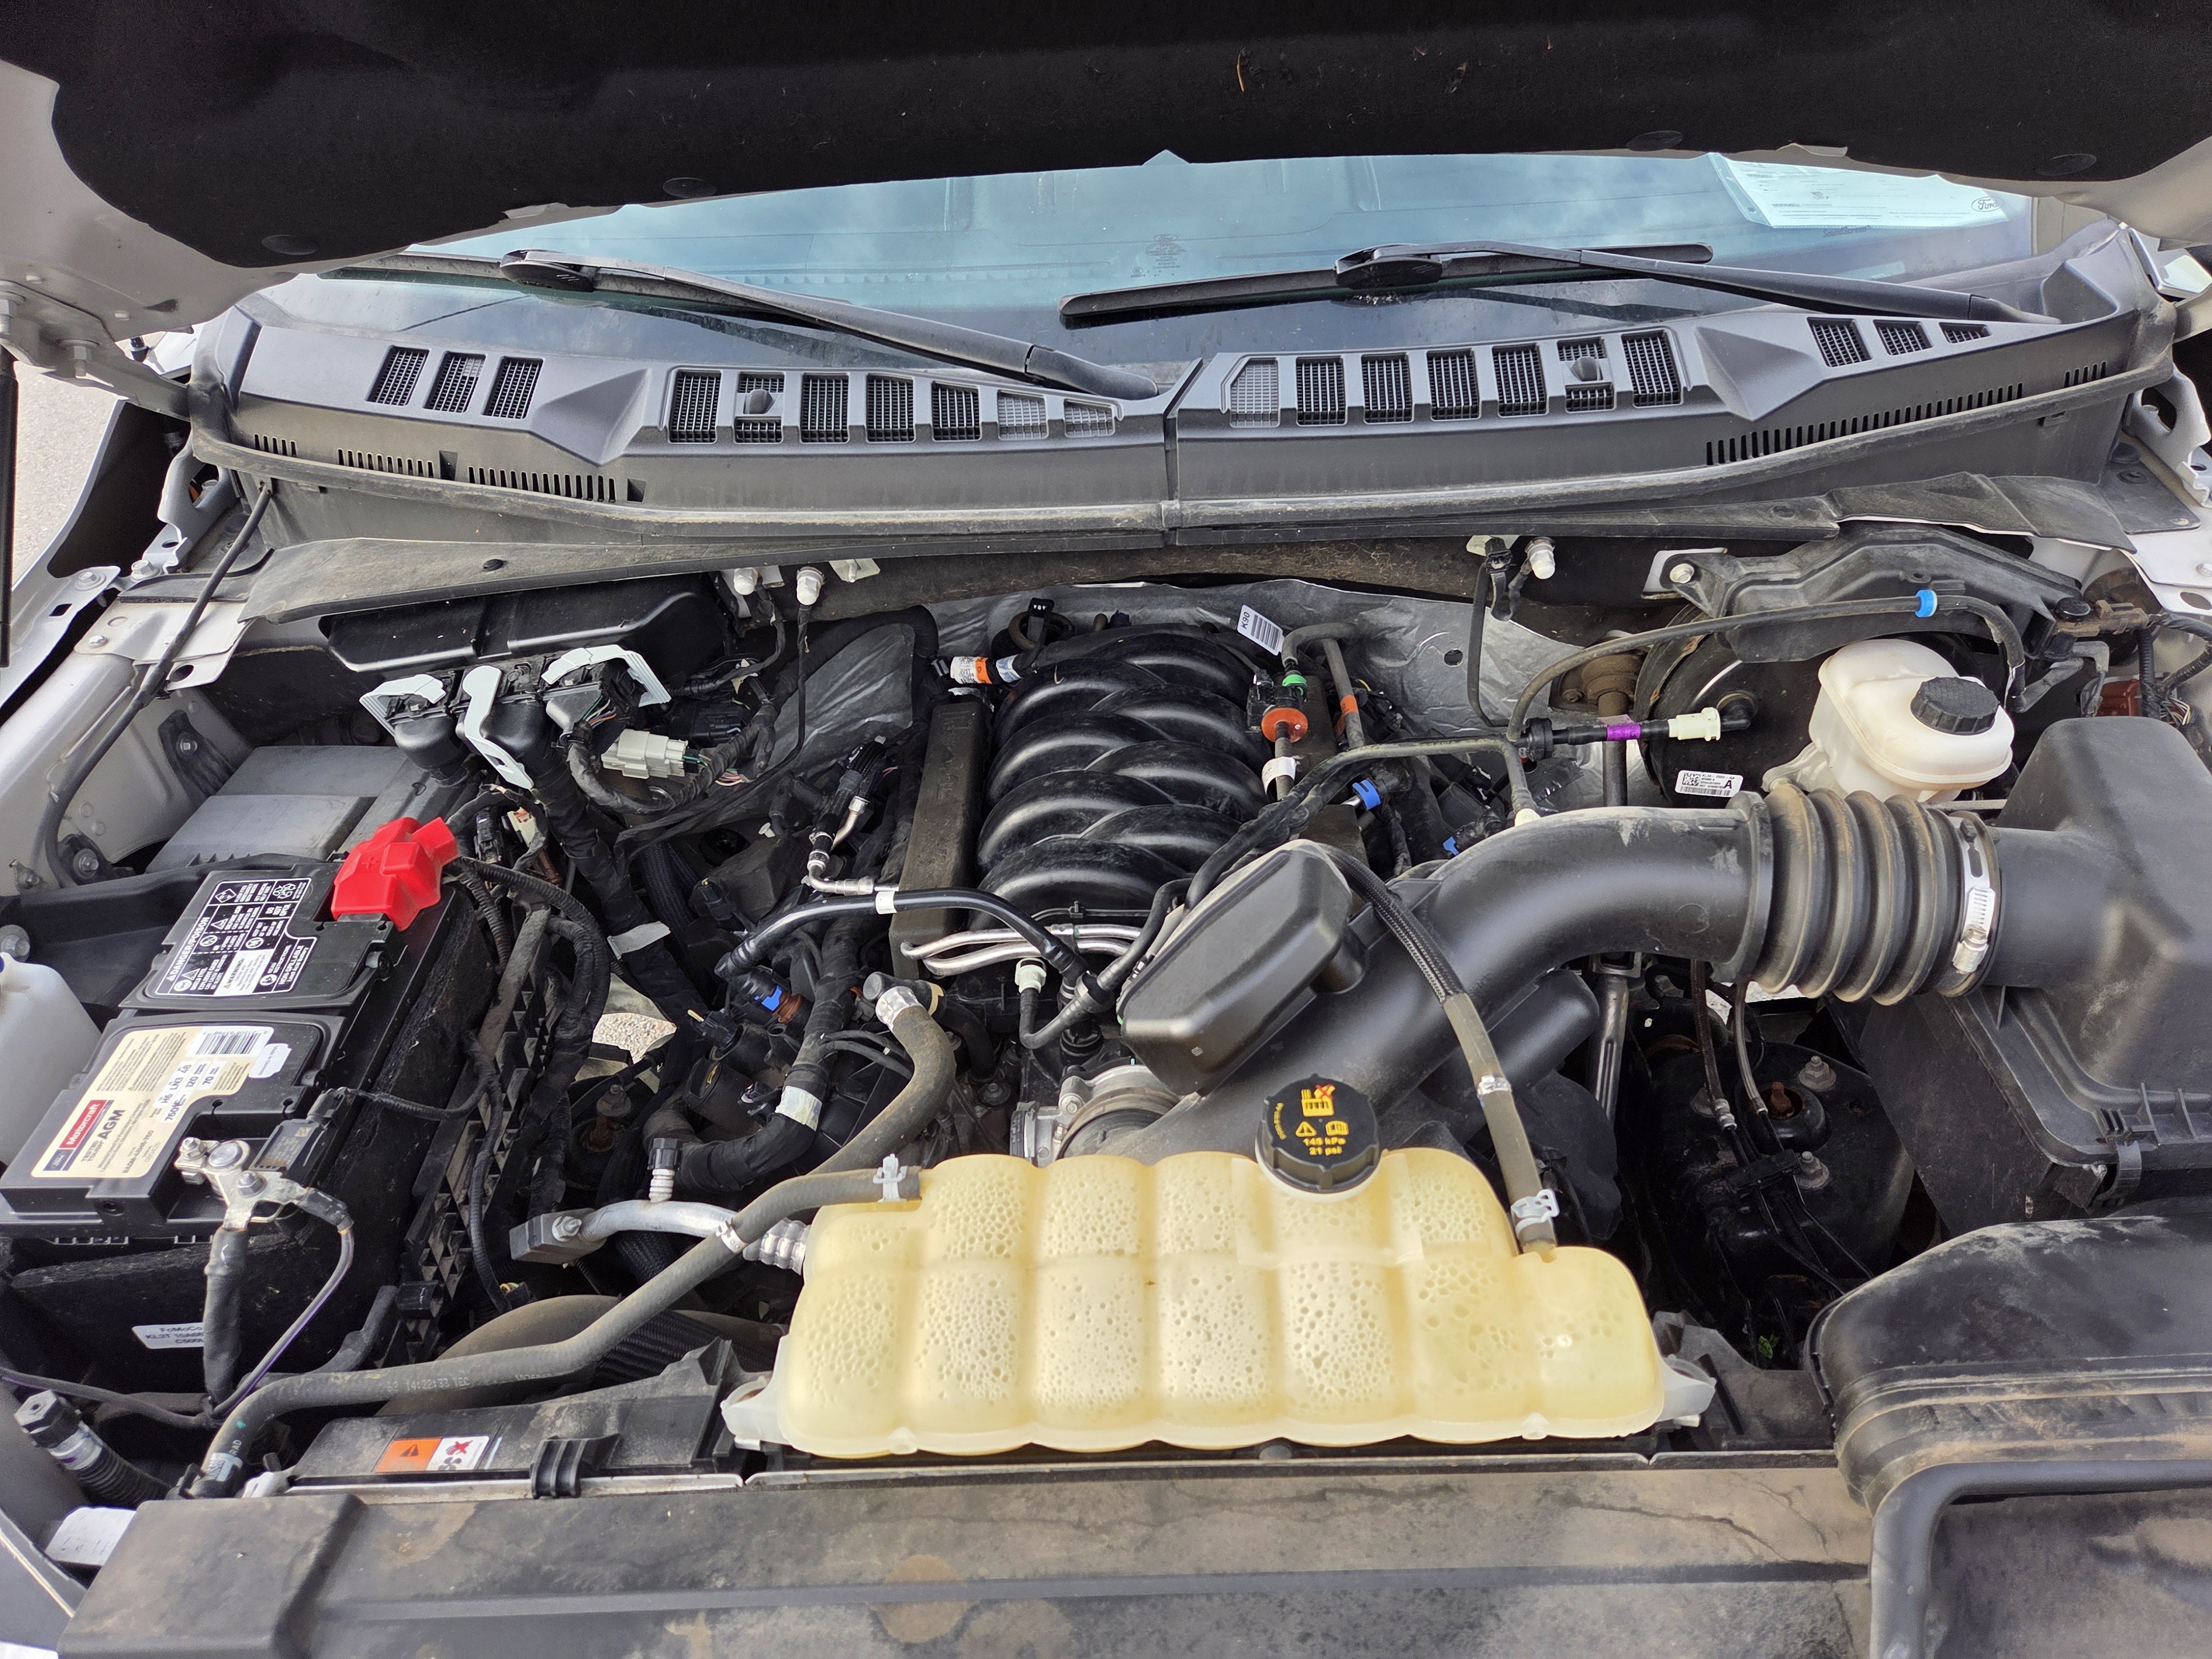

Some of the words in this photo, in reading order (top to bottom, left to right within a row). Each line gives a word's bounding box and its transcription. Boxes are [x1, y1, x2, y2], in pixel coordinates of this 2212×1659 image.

[1241, 612, 1250, 629] K90
[1724, 780, 1732, 789] A
[169, 917, 210, 974] DANGER/POISON
[278, 945, 304, 984] NON-SPILLABLE
[160, 1094, 173, 1103] H6
[169, 1077, 184, 1089] LN3
[180, 1065, 192, 1073] 48
[185, 1076, 199, 1087] 120
[201, 1076, 215, 1084] 70
[164, 1108, 180, 1120] 760
[65, 1104, 100, 1144] Motorcraft
[97, 1110, 126, 1139] AGM
[1303, 1138, 1324, 1146] 145
[1324, 1137, 1347, 1145] kPa
[1309, 1147, 1323, 1155] 21
[1325, 1146, 1342, 1156] psi
[229, 1440, 242, 1455] RAD
